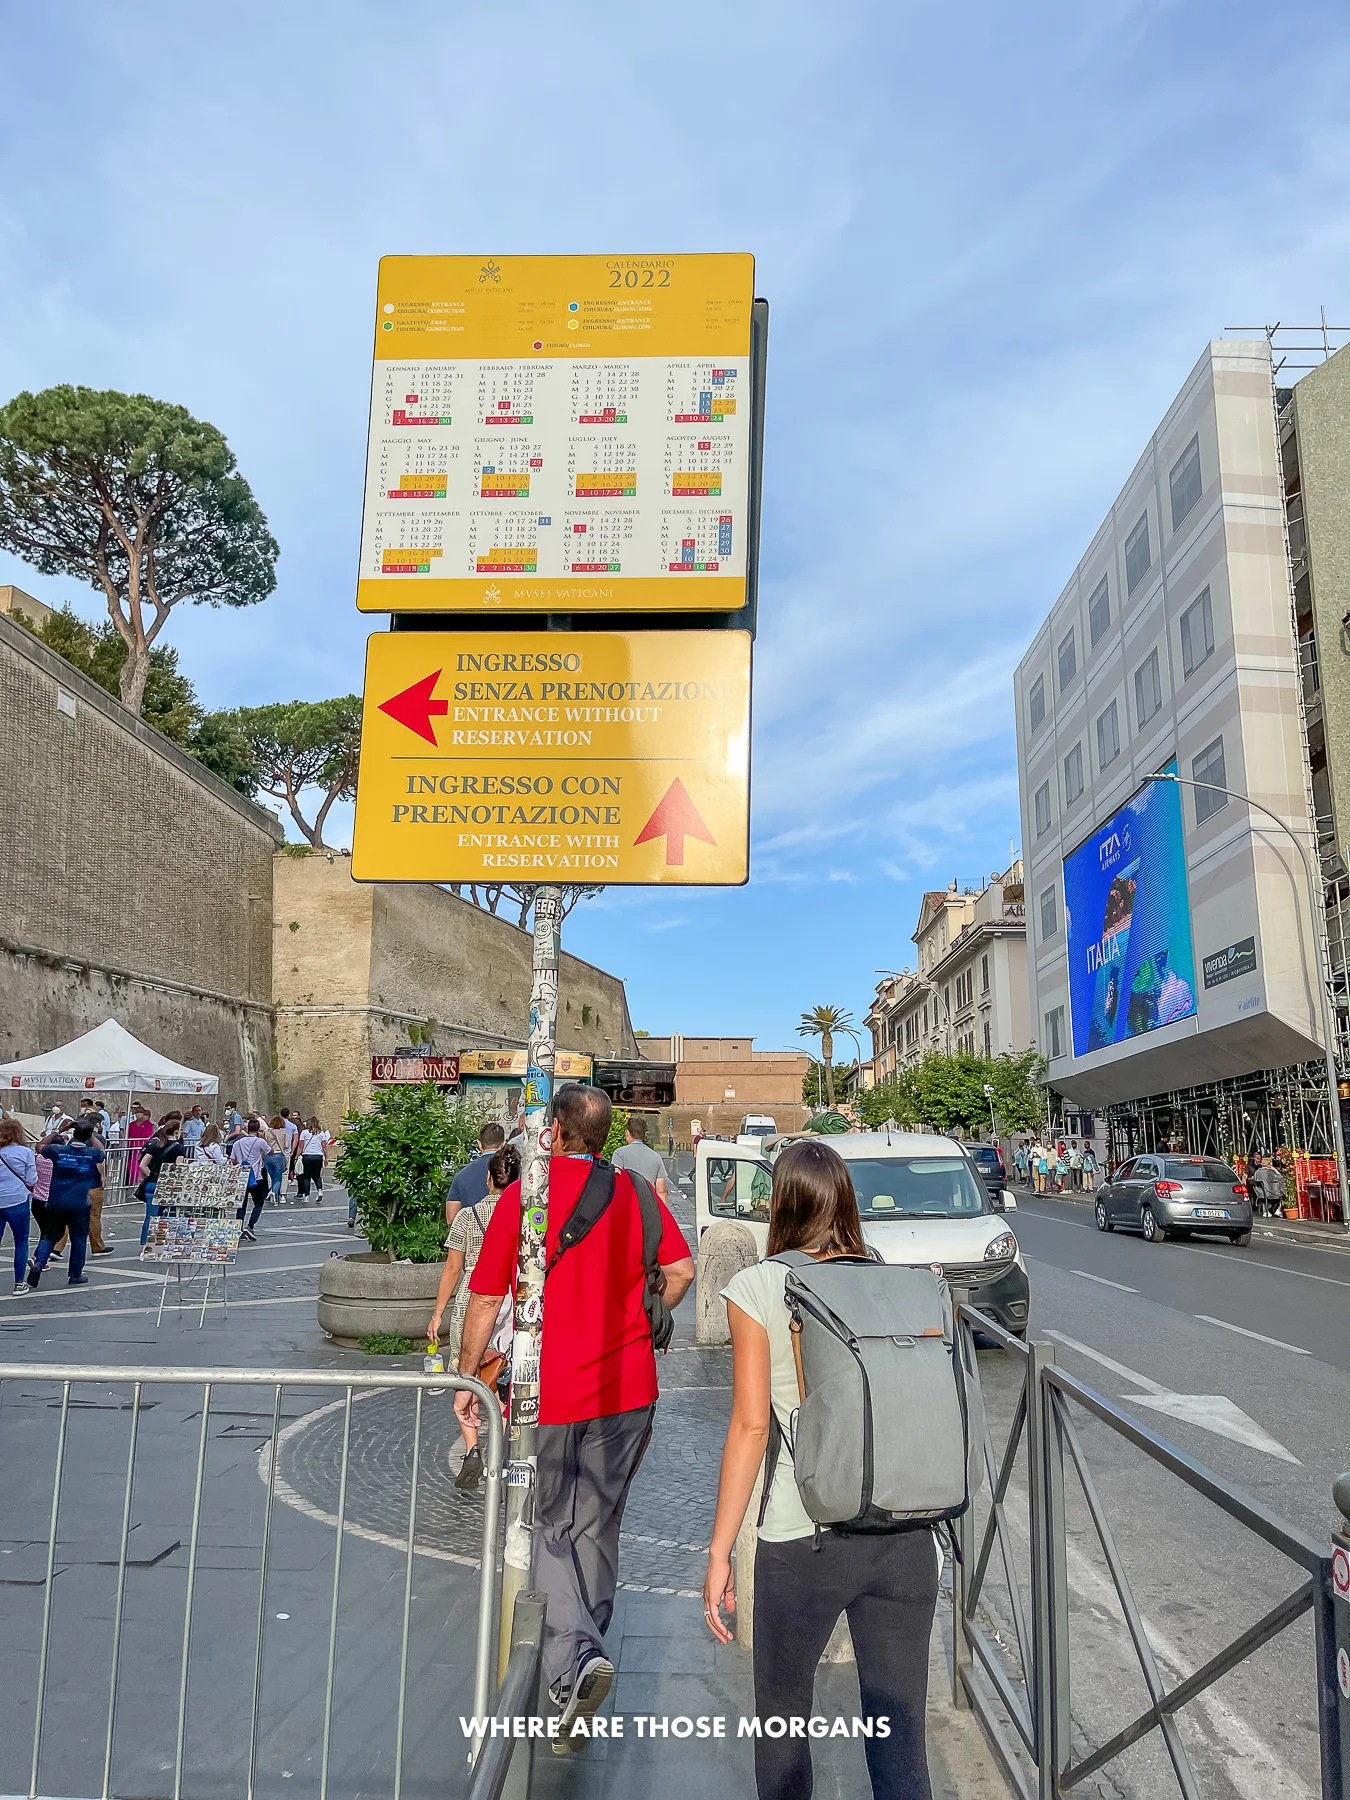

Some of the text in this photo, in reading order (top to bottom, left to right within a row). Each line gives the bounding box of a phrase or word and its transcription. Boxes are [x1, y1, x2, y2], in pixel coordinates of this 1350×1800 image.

[606, 260, 675, 269] CALENDARIO
[608, 269, 671, 289] 2022
[513, 588, 613, 598] MVSEI VATICANI
[455, 653, 581, 672] INGRESSO
[453, 682, 535, 701] SENZA
[452, 707, 662, 723] ENTRANCE WITHOUT
[451, 730, 593, 746] RESERVATION
[405, 775, 622, 795] INGRESSO CON
[392, 805, 621, 825] PRENOTAZIONE
[457, 834, 621, 848] ENTRANCE WITH
[1099, 832, 1121, 862] ITA
[482, 853, 620, 869] RESERVATION
[1101, 850, 1121, 872] AIRWAYS
[1086, 933, 1120, 975] ITALIA
[49, 1076, 84, 1084] VATICANI
